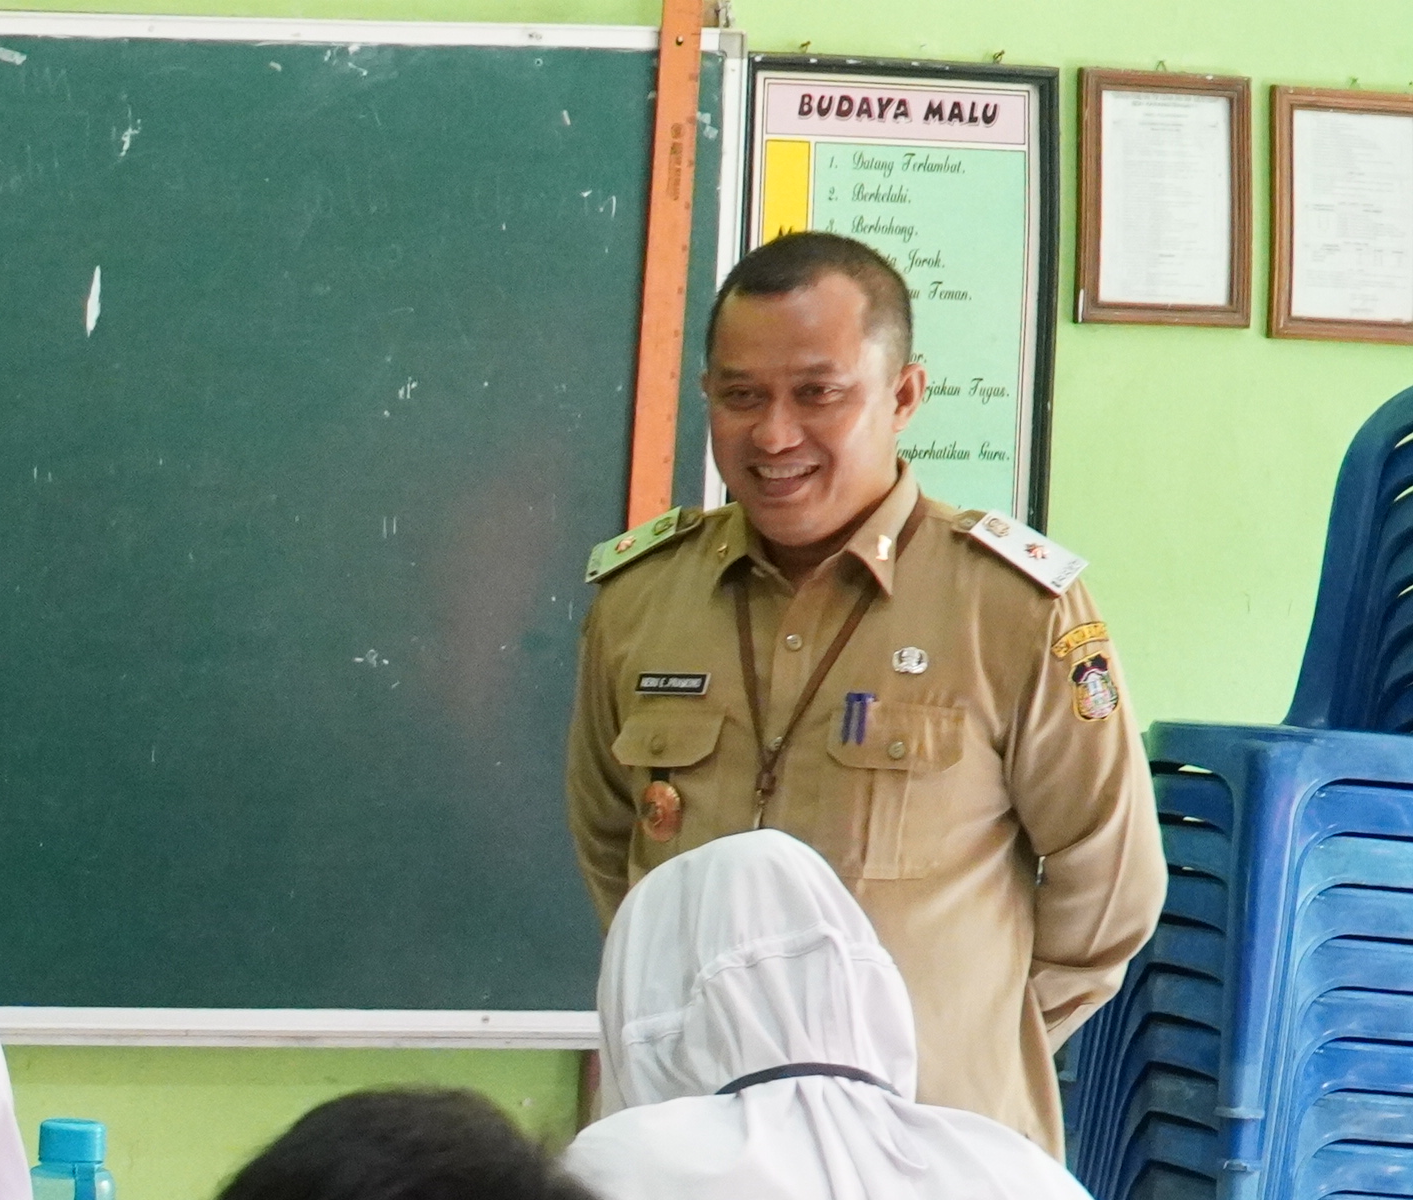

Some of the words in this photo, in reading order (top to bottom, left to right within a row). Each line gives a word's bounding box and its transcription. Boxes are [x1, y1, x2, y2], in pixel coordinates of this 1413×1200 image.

[798, 93, 911, 121] BUDAYA
[922, 99, 999, 126] MALU
[829, 155, 838, 169] 1.
[852, 151, 894, 178] Datang
[901, 153, 966, 174] Terlambat.
[828, 186, 838, 201] 2.
[852, 183, 911, 204] Berkelahi.
[851, 215, 918, 242] Berbohong.
[903, 248, 945, 274] Jorok.
[928, 280, 972, 301] Teman.
[969, 377, 1010, 405] Tugas.
[979, 441, 1010, 461] Guru.
